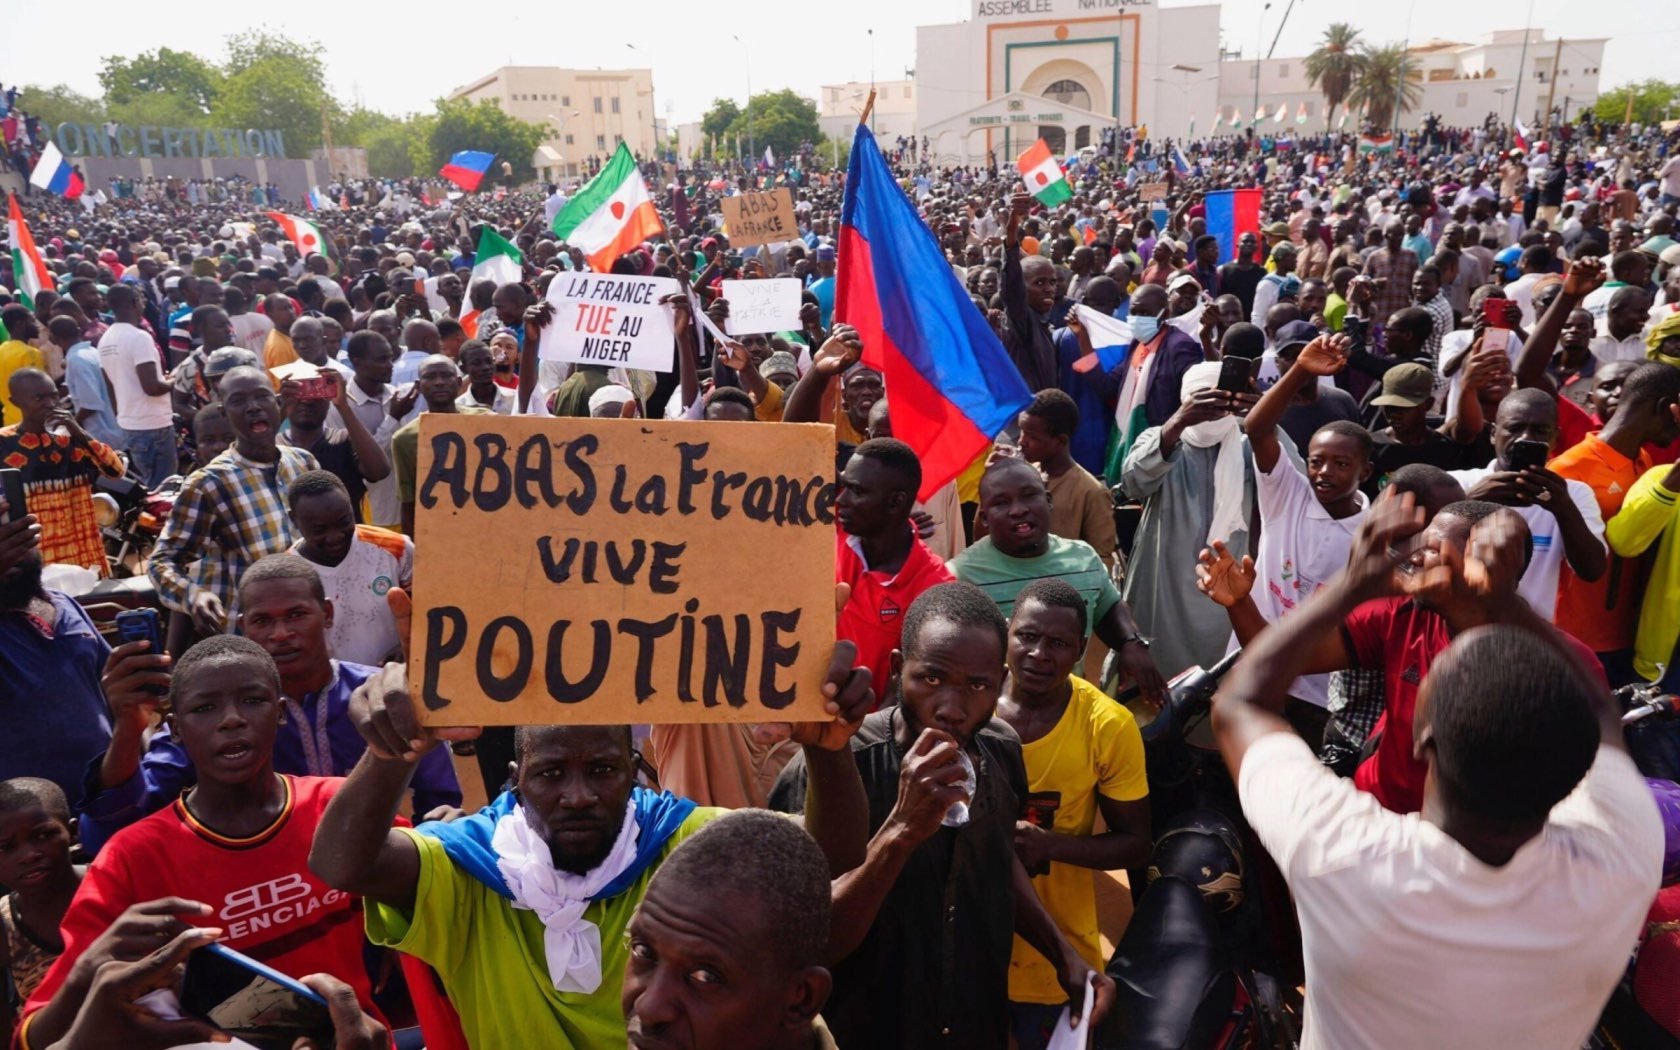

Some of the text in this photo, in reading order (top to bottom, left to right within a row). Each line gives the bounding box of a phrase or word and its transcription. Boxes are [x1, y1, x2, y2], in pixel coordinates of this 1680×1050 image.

[740, 190, 779, 218] ABAS
[566, 278, 656, 305] LA FRANCE
[575, 303, 642, 337] TUE AU
[580, 337, 631, 362] NIGER
[419, 431, 836, 527] ABAS la France
[537, 535, 687, 594] VIVE
